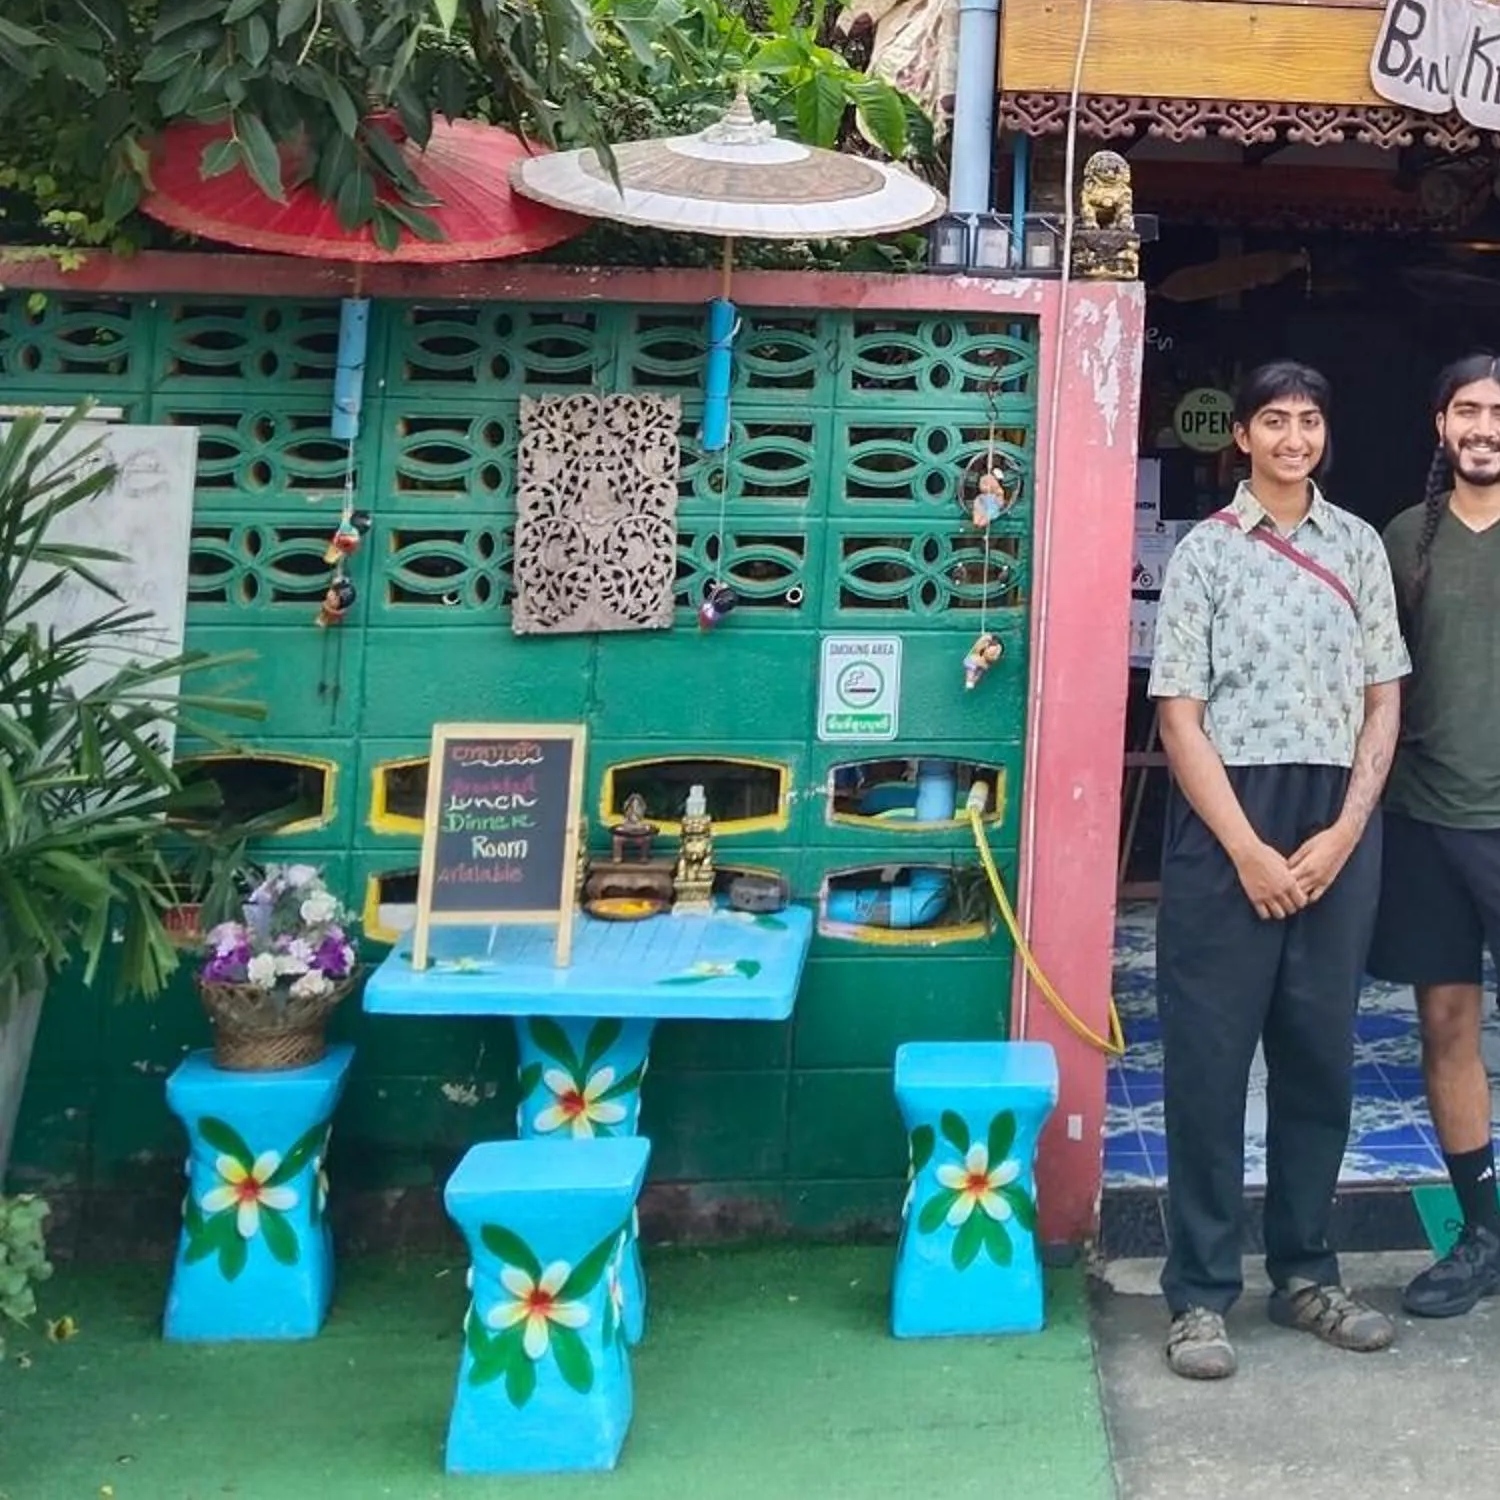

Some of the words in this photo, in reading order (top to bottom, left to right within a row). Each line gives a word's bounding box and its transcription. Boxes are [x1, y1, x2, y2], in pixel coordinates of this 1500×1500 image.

[1181, 409, 1234, 435] OPEN
[829, 643, 869, 655] SMOKING
[871, 643, 895, 655] AREA
[471, 835, 529, 860] Room
